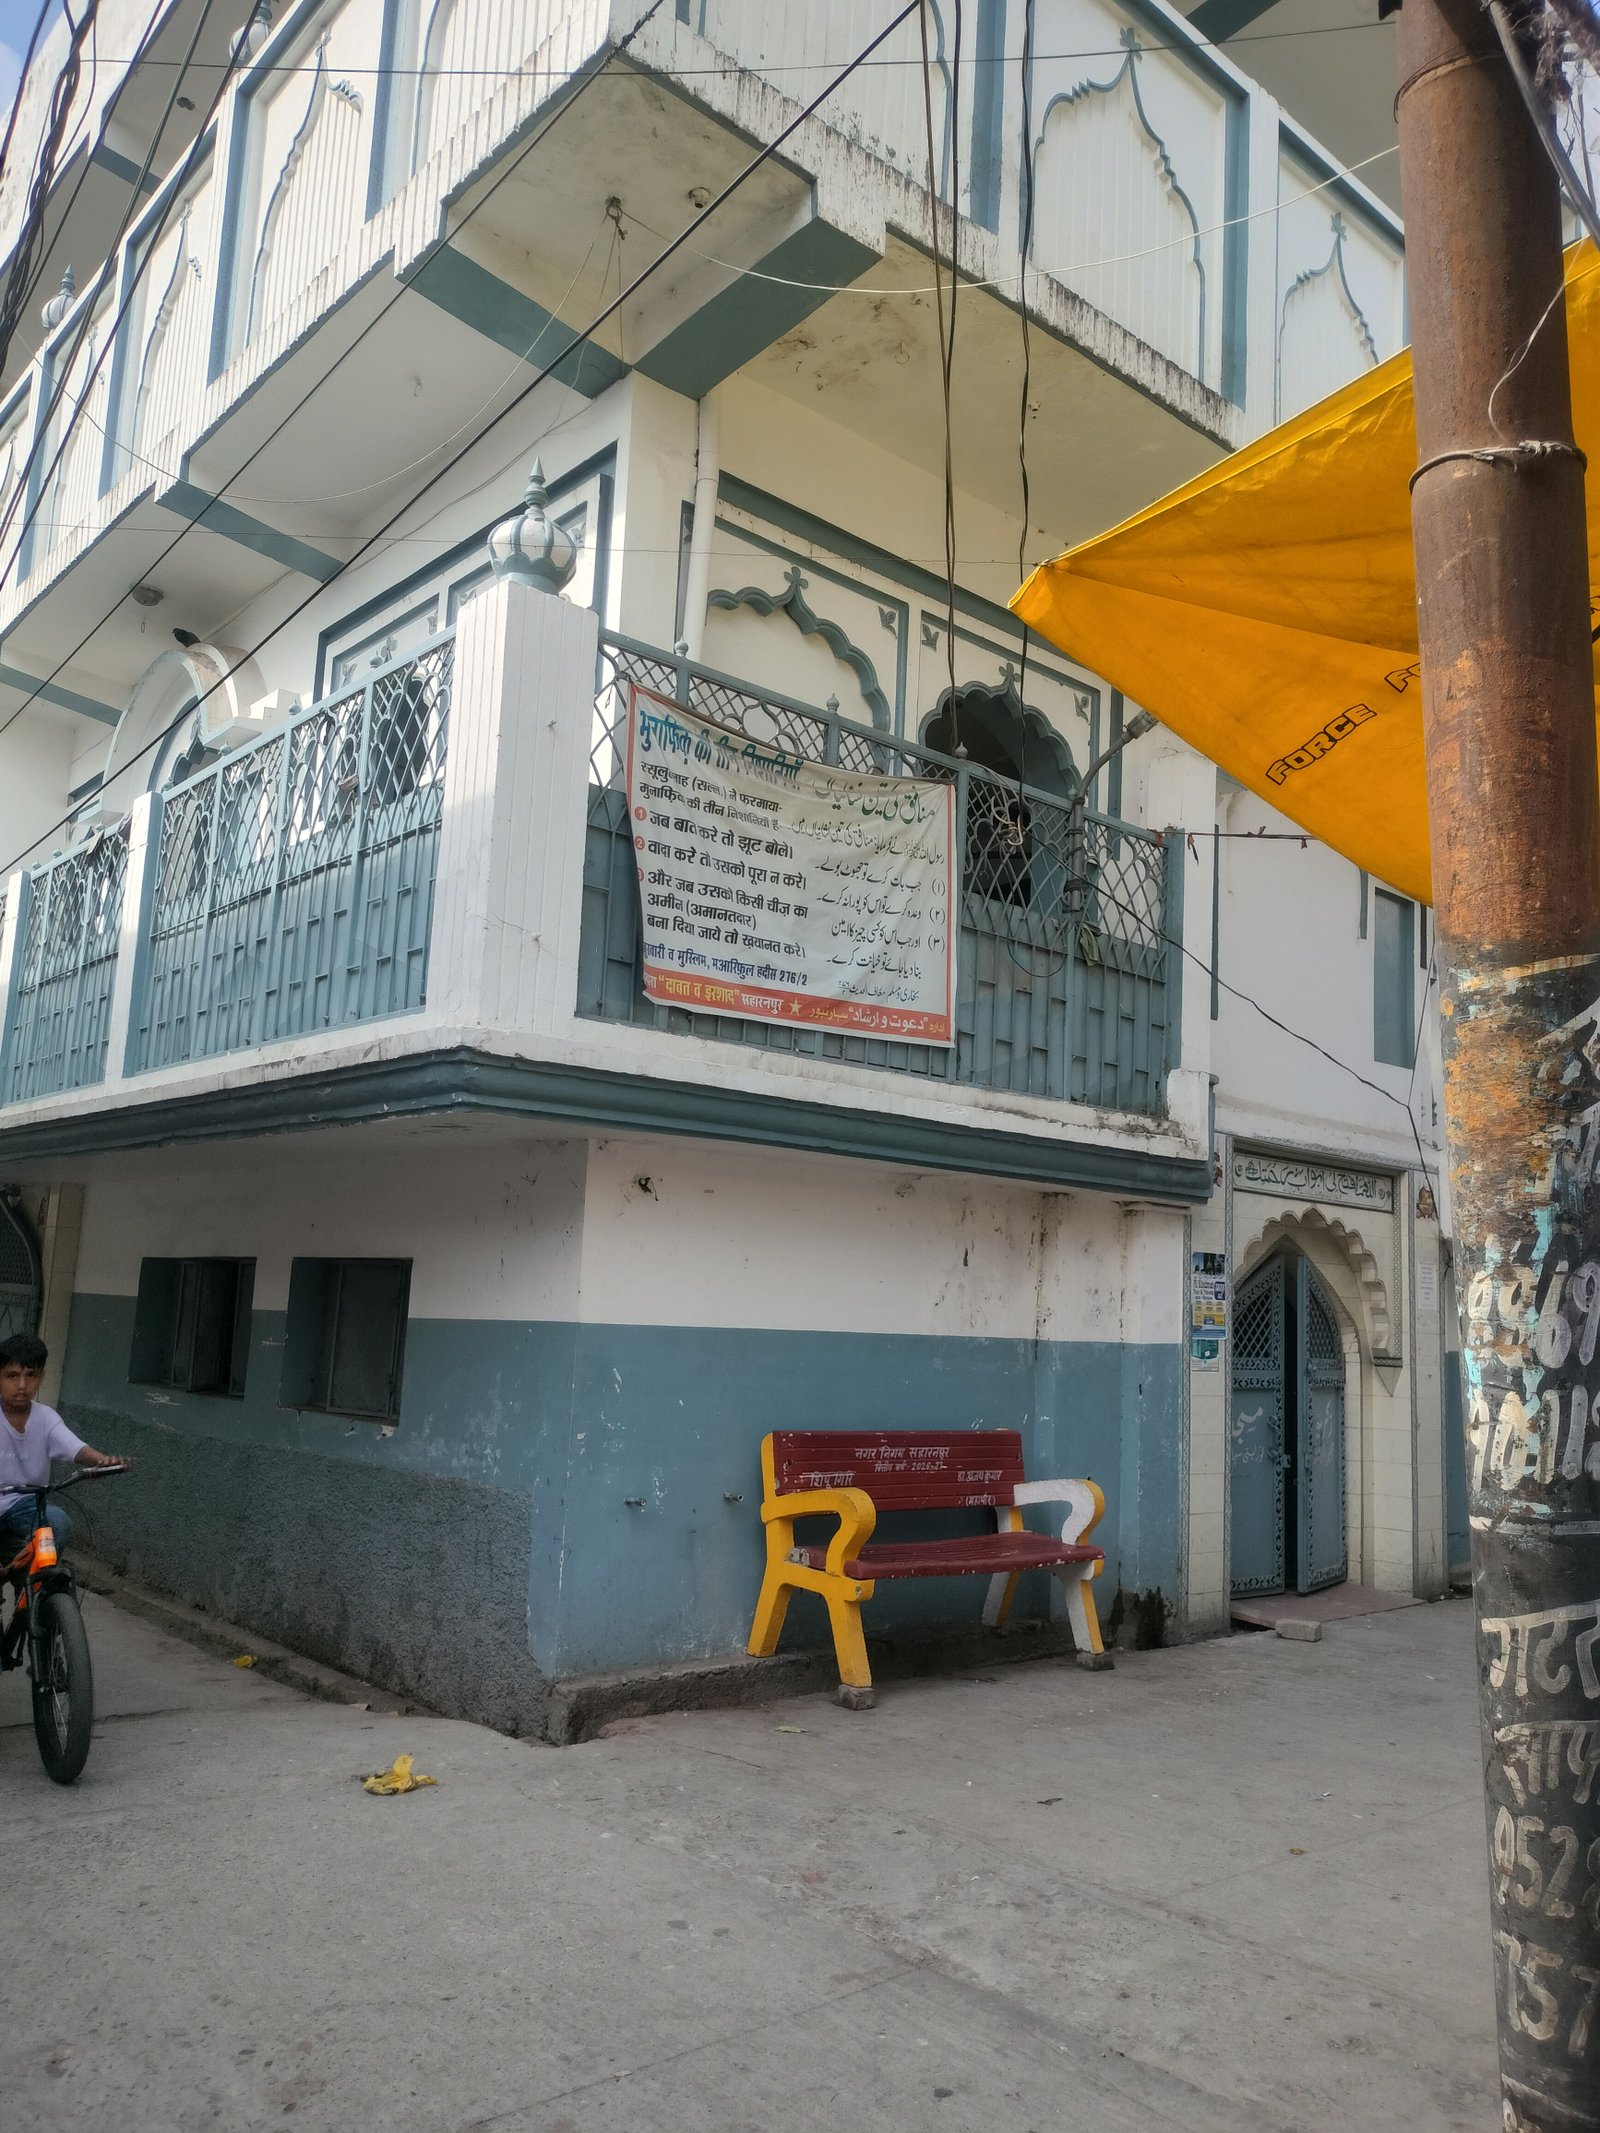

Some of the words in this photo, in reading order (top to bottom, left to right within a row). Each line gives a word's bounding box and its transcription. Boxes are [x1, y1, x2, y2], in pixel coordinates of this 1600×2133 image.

[1266, 703, 1378, 785] FORCE
[686, 794, 700, 811] की
[703, 800, 725, 816] तीन
[729, 788, 737, 801] ने
[900, 785, 935, 824] منافق
[650, 811, 670, 829] जब
[674, 817, 697, 835] बात
[697, 825, 717, 843] करे
[721, 829, 734, 847] तो
[738, 835, 762, 856] झूट
[648, 840, 671, 858] वादा
[674, 846, 697, 864] करे
[700, 851, 711, 867] तो
[712, 857, 745, 878] उसको
[749, 866, 767, 886] पूरा
[770, 871, 780, 885] न
[648, 869, 672, 888] और
[675, 877, 694, 893] जब
[698, 882, 733, 903] उसको
[736, 890, 763, 910] किसी
[767, 898, 790, 917] चीज़
[793, 904, 808, 918] का
[890, 871, 904, 891] بات
[906, 881, 921, 892] جب
[647, 892, 683, 912] अमीन
[686, 899, 757, 931] (अमानतदार)
[647, 913, 669, 930] बना
[673, 915, 695, 935] दिया
[697, 926, 721, 942] जाये
[724, 929, 738, 945] तो
[669, 948, 675, 961] व
[757, 964, 777, 981] हदीस
[780, 970, 808, 987] 276/2
[694, 983, 702, 997] व
[855, 1448, 877, 1460] नगर
